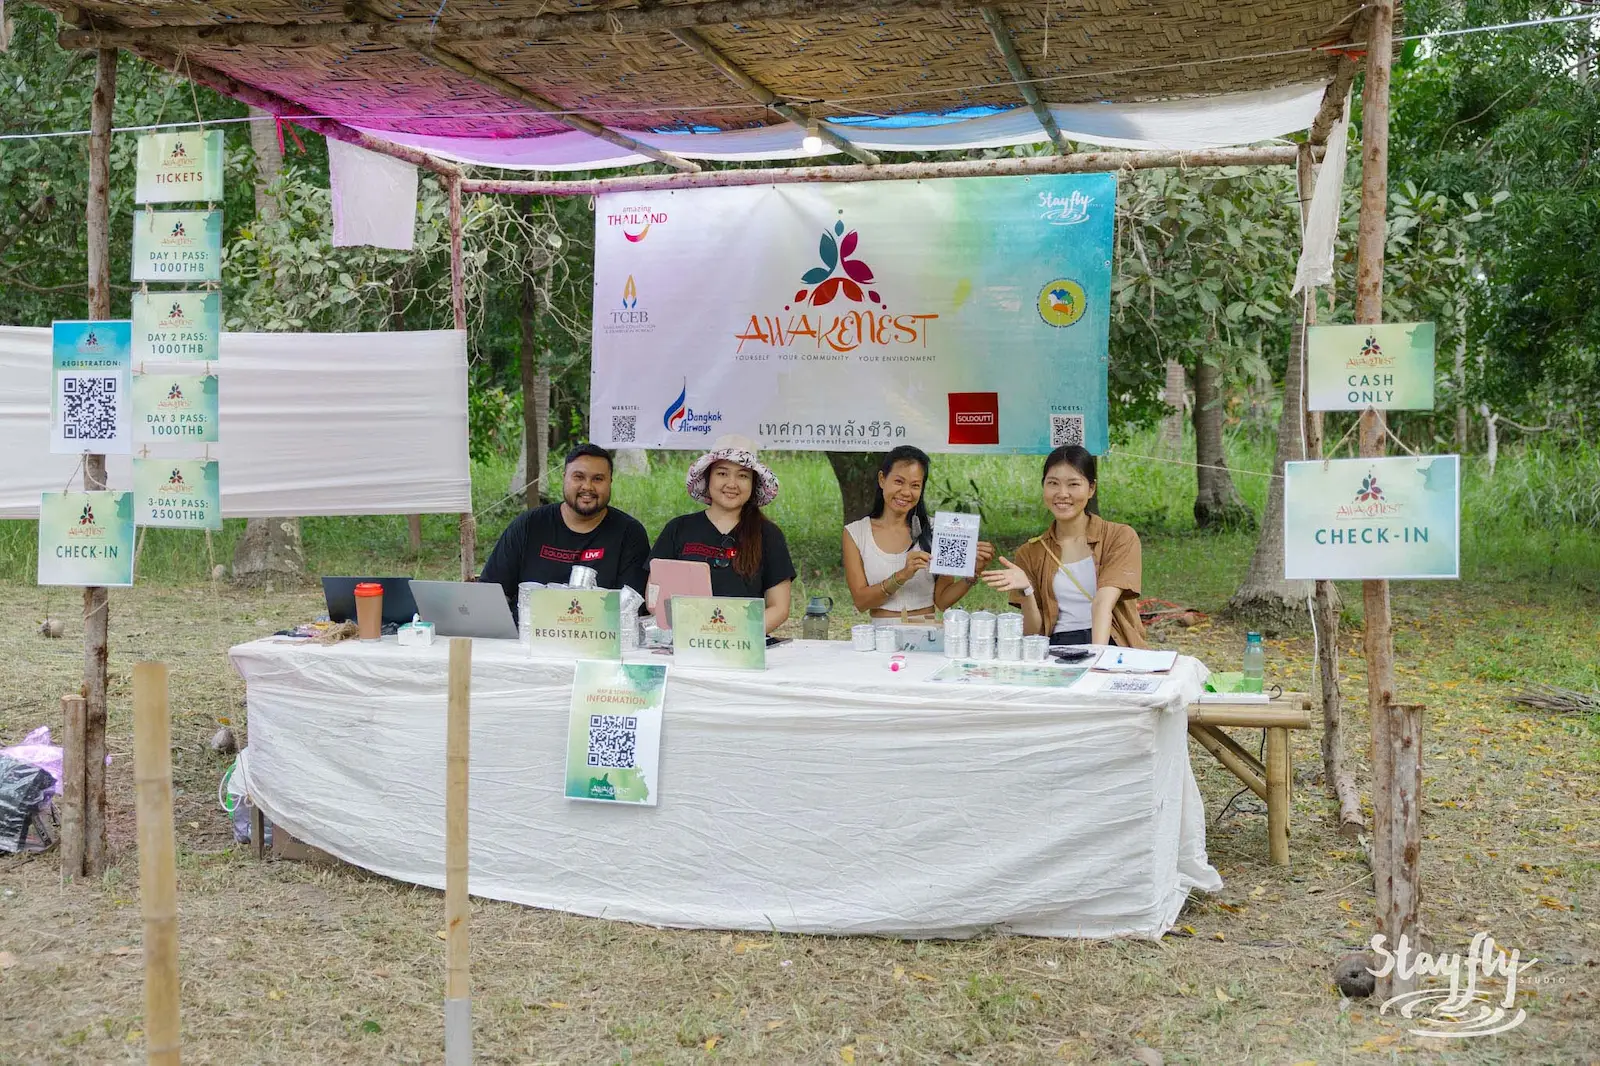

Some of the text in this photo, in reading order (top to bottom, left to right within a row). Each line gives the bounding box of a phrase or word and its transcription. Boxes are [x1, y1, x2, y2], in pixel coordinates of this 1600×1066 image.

[156, 171, 203, 184] TICKETS
[622, 205, 652, 213] amazing
[607, 212, 668, 226] THAILAND
[150, 251, 209, 260] DAY 1 PASS:
[153, 262, 205, 273] 1000THB
[610, 311, 649, 324] TCEB
[147, 333, 208, 342] DAY 2 PASS:
[734, 310, 939, 354] AWAKENEST
[152, 344, 204, 354] 1000THB
[1348, 374, 1394, 387] CASH
[1347, 390, 1394, 403] ONLY
[147, 414, 207, 423] DAY 3 PASS:
[687, 408, 722, 424] Bangkok
[957, 415, 992, 423] SOLDOUTT
[151, 425, 204, 435] 1000THB
[678, 419, 712, 435] Airways
[759, 420, 906, 437] เทศกาลพลังชีวิต
[148, 497, 209, 509] 3-DAY PASS:
[152, 509, 205, 520] 2500THB
[1315, 526, 1429, 545] CHECK-IN
[56, 545, 118, 559] CHECK-IN
[535, 628, 617, 640] REGISTRATION
[689, 638, 751, 650] CHECK-IN
[586, 694, 647, 705] INFORMATION
